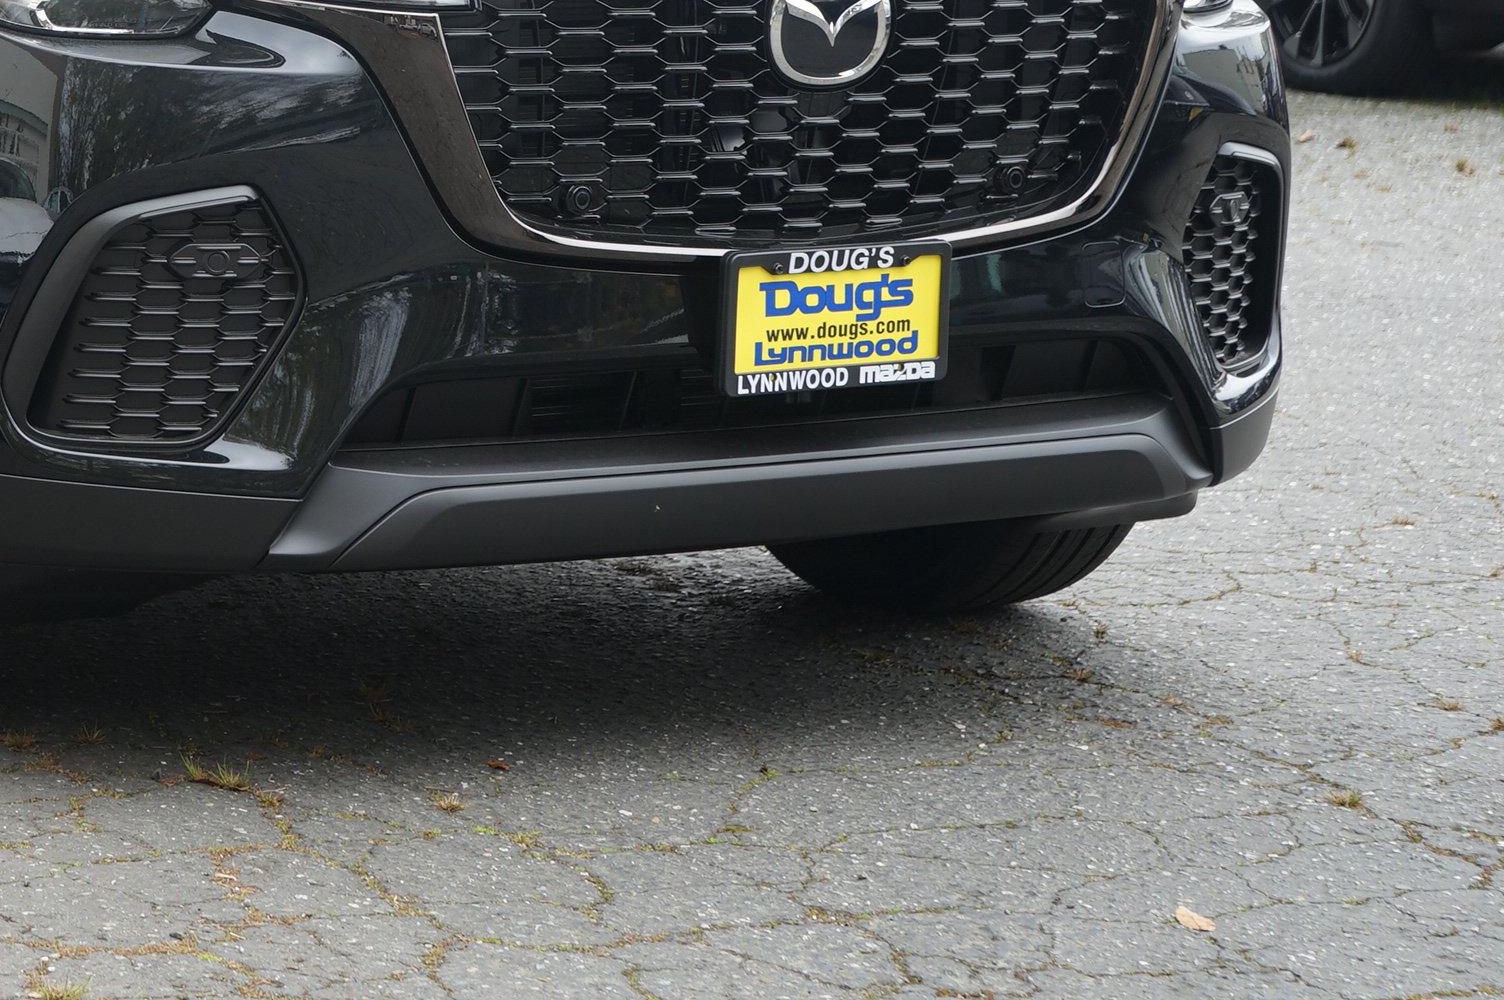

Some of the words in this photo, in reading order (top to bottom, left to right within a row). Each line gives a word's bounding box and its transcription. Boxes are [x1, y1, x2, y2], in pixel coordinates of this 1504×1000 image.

[788, 246, 895, 274] DOUG'S
[759, 273, 914, 322] Doug's
[766, 318, 911, 343] www.dougs.com
[754, 330, 919, 366] Lynnwood
[737, 366, 849, 395] LYNNWOOD
